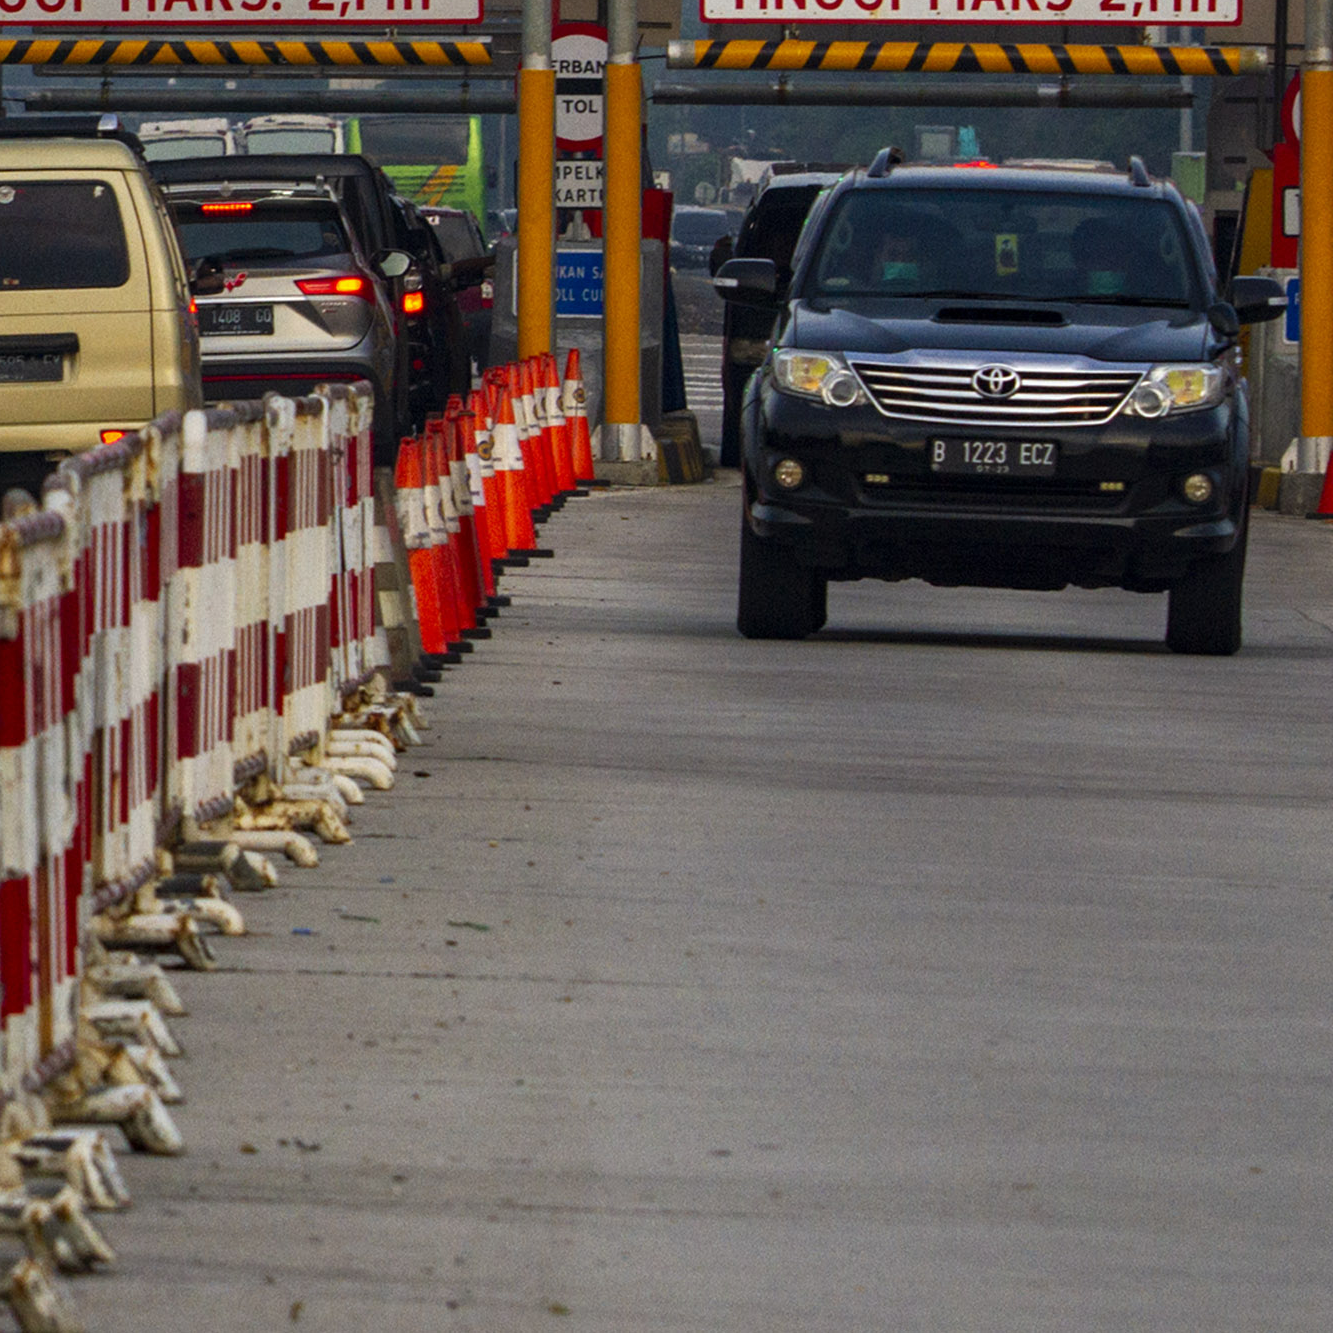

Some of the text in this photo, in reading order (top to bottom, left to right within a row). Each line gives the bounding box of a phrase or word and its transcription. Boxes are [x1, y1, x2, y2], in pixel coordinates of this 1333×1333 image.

[562, 99, 599, 114] TOL
[934, 440, 1054, 465] B 1223 ECZ
